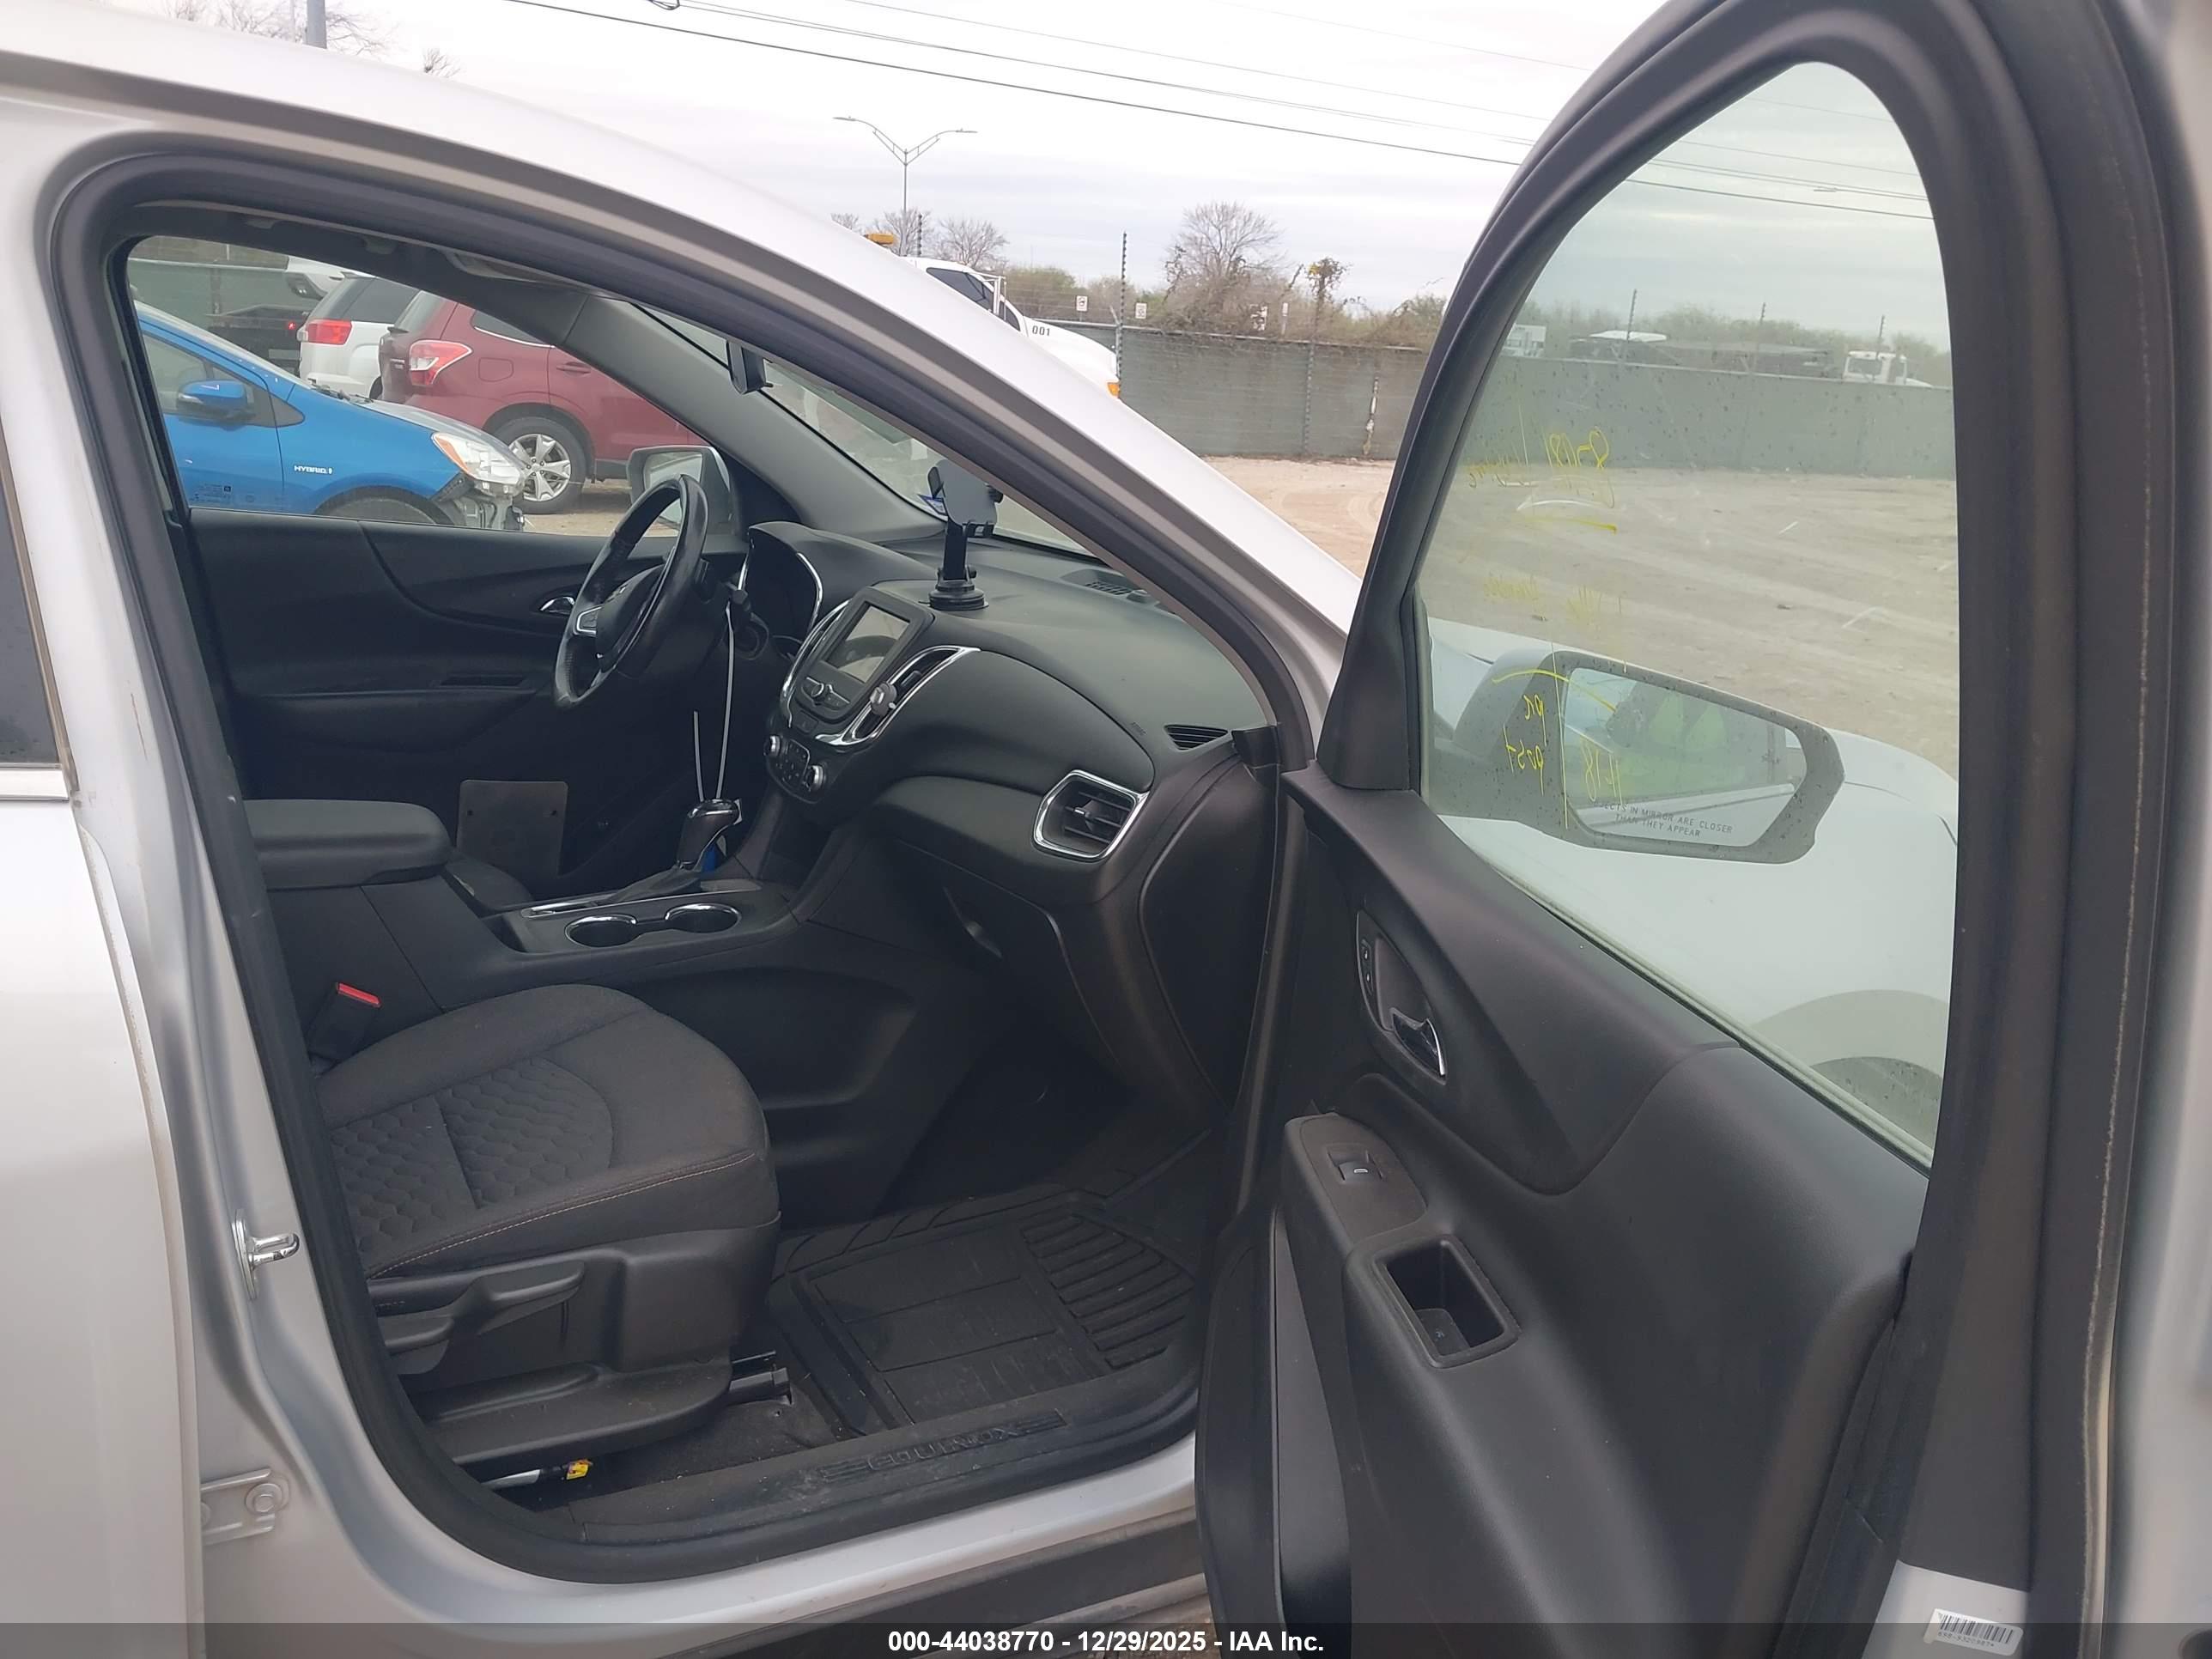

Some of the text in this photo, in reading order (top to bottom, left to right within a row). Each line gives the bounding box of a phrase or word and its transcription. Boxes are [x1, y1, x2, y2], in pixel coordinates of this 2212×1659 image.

[1032, 325, 1050, 337] 001
[294, 465, 327, 475] HYBRID
[1629, 805, 1638, 815] IN
[1641, 808, 1674, 822] MIRROR
[1677, 816, 1695, 826] ARE
[1698, 820, 1733, 833] CLOSER
[1641, 819, 1664, 830] THEY
[1667, 824, 1701, 838] APPEAR
